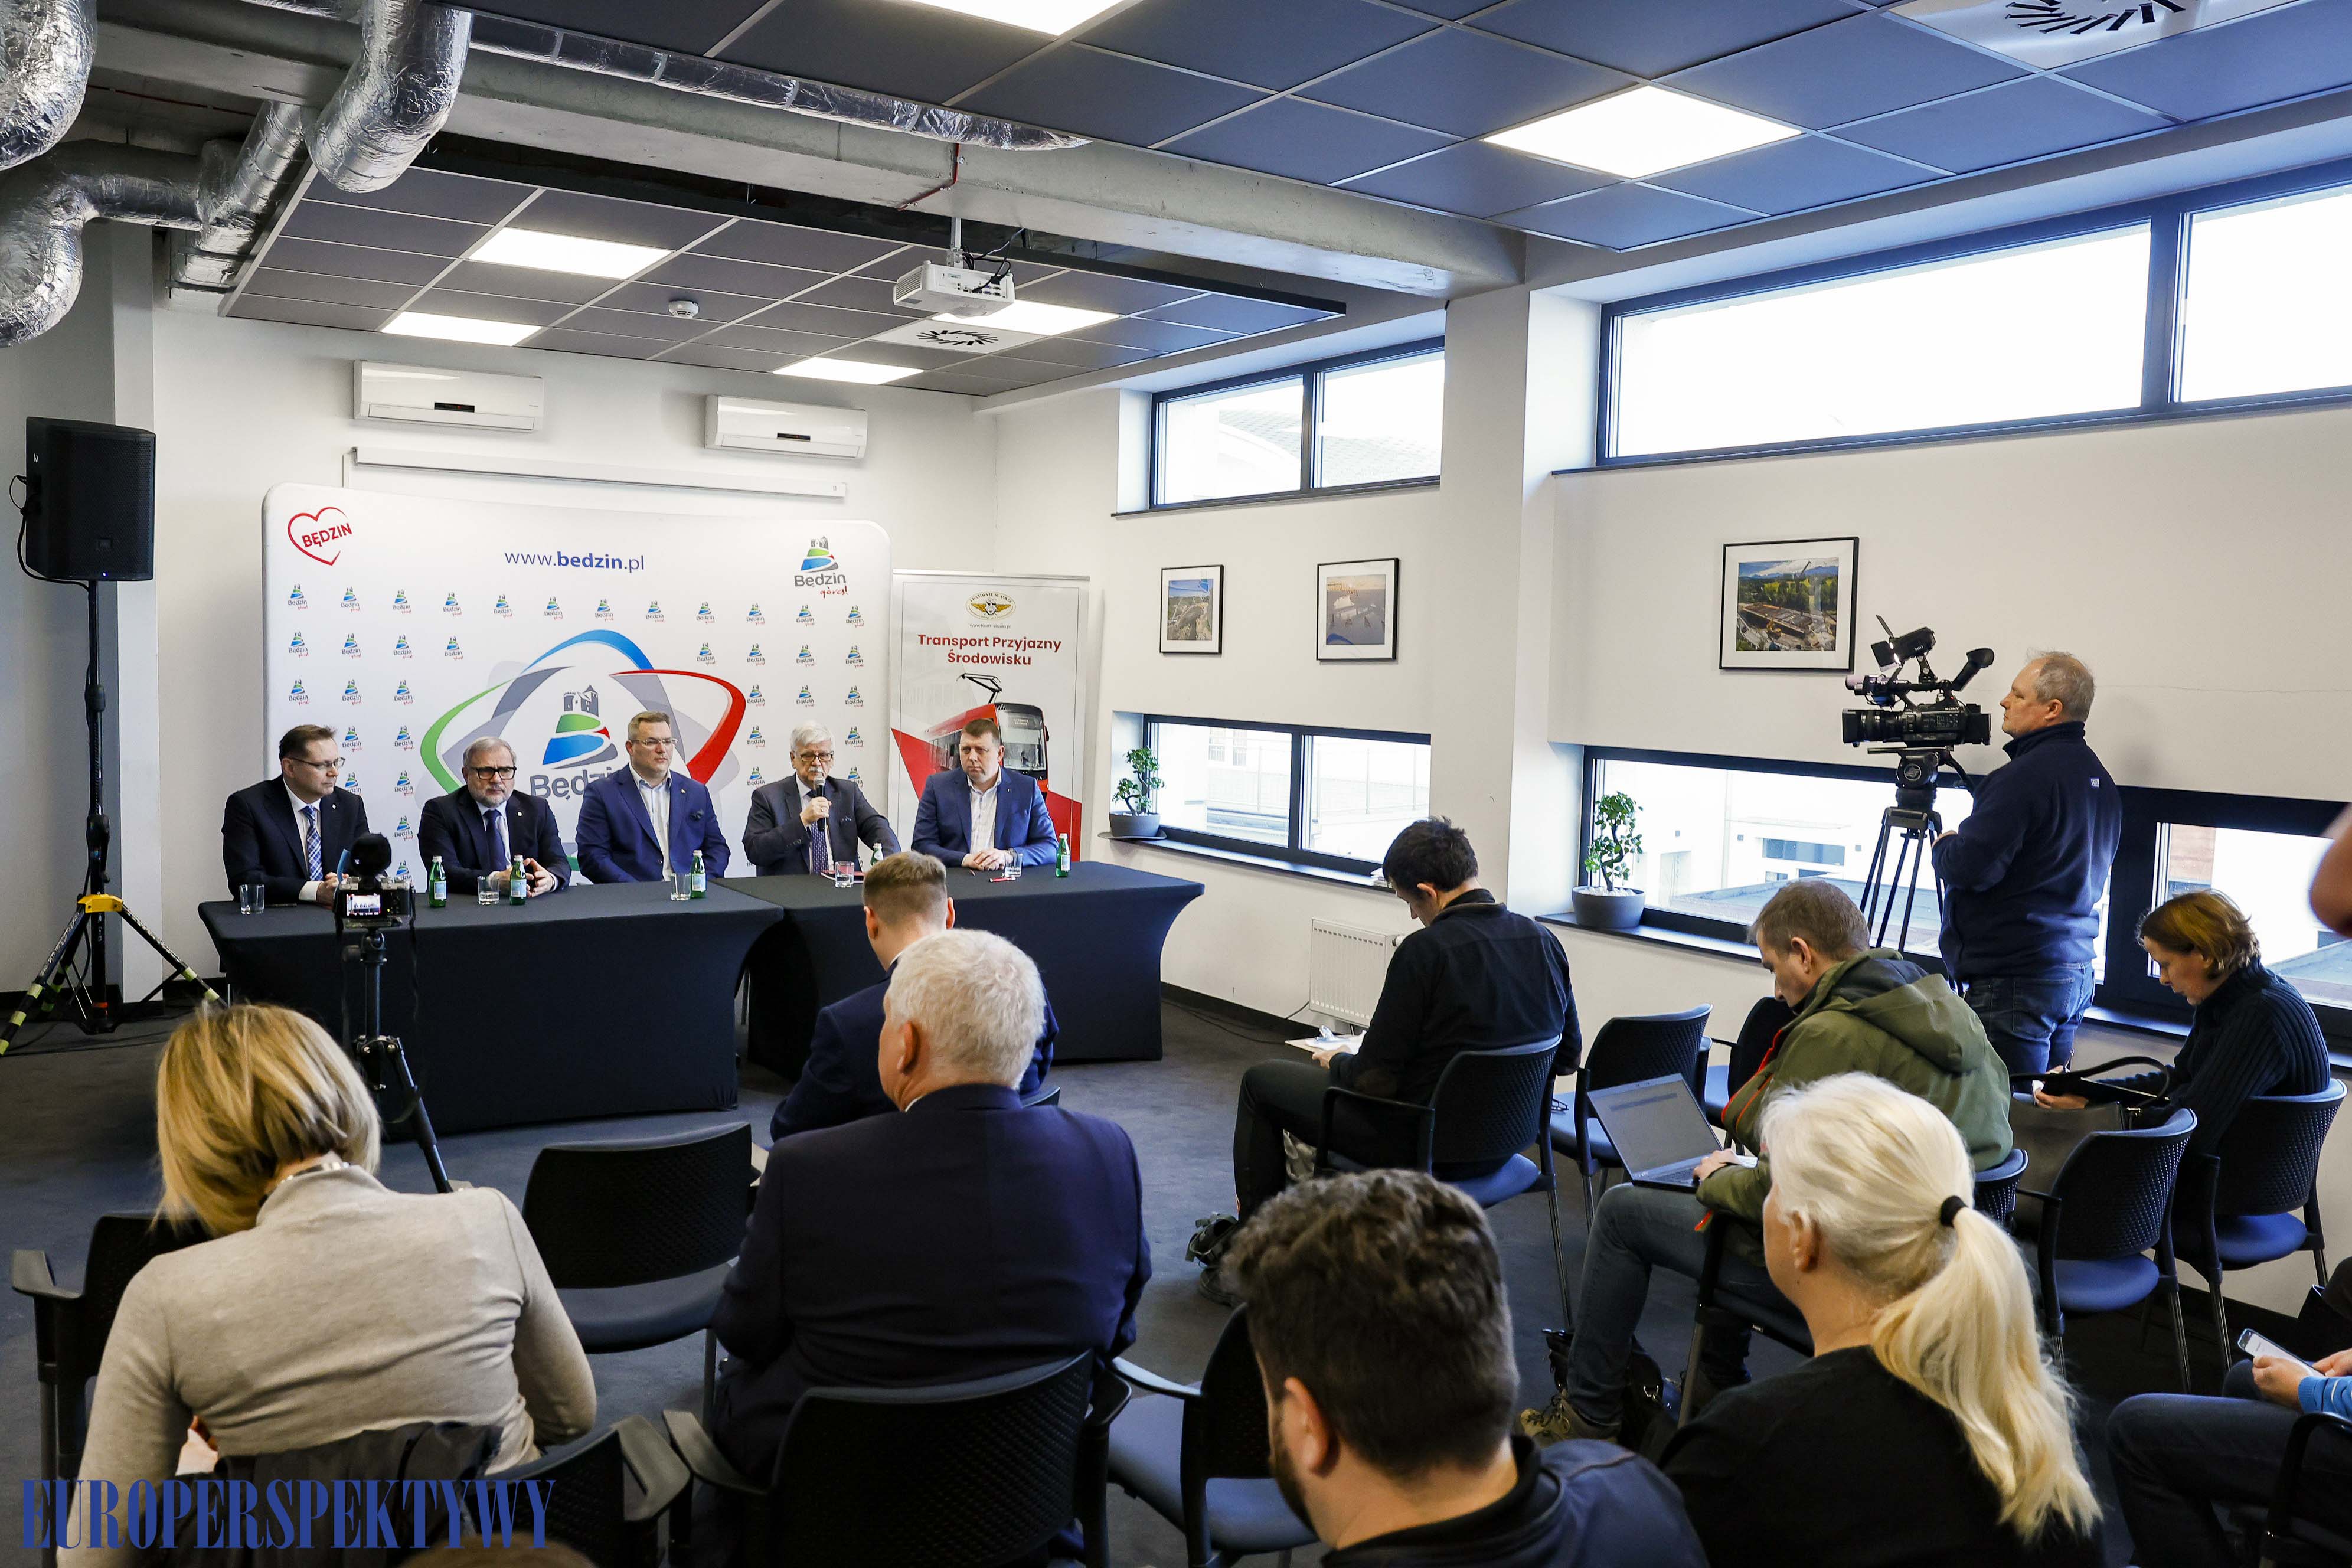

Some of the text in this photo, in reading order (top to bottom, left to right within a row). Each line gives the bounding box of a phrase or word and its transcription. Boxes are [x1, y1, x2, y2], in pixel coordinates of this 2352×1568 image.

[302, 523, 352, 547] BĘDZIN
[505, 551, 644, 573] www.bedzin.pl
[794, 573, 846, 587] Będzin
[918, 634, 1061, 652] Transport Przyjazny
[948, 649, 1031, 665] Środowisku
